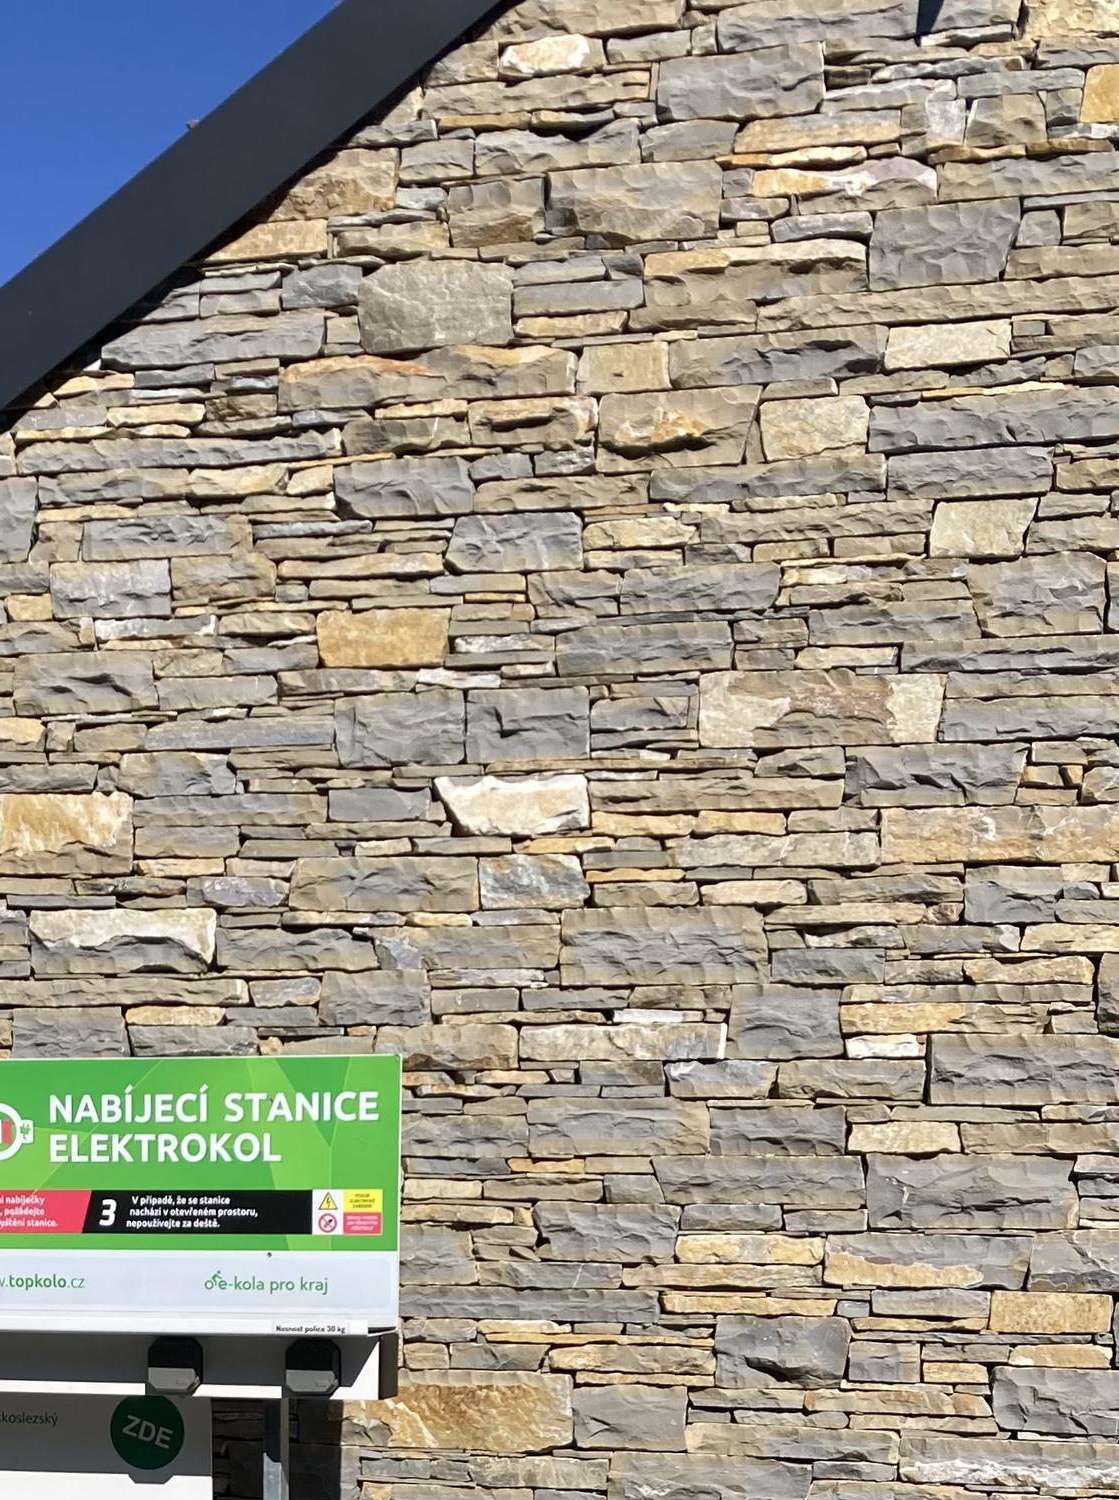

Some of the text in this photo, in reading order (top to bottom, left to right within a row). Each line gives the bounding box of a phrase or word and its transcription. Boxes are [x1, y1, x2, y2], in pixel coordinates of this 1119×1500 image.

[49, 1084, 380, 1124] NABÍJECÍ STANICE
[49, 1131, 282, 1163] ELEKTROKOL
[6, 1195, 45, 1206] nabíječky
[132, 1196, 139, 1205] V
[140, 1195, 175, 1206] případě,
[177, 1195, 187, 1205] že
[199, 1196, 231, 1205] stanice
[4, 1206, 45, 1218] požádejte
[99, 1199, 118, 1227] 3
[130, 1207, 162, 1216] nachází
[170, 1207, 217, 1216] otevřeném
[218, 1208, 259, 1218] prostoru,
[27, 1218, 59, 1228] stanice.
[126, 1218, 181, 1229] nepoužívejte
[193, 1218, 221, 1228] deště.
[218, 1275, 328, 1295] e-kola pro kraj
[122, 1415, 174, 1449] ZDE
